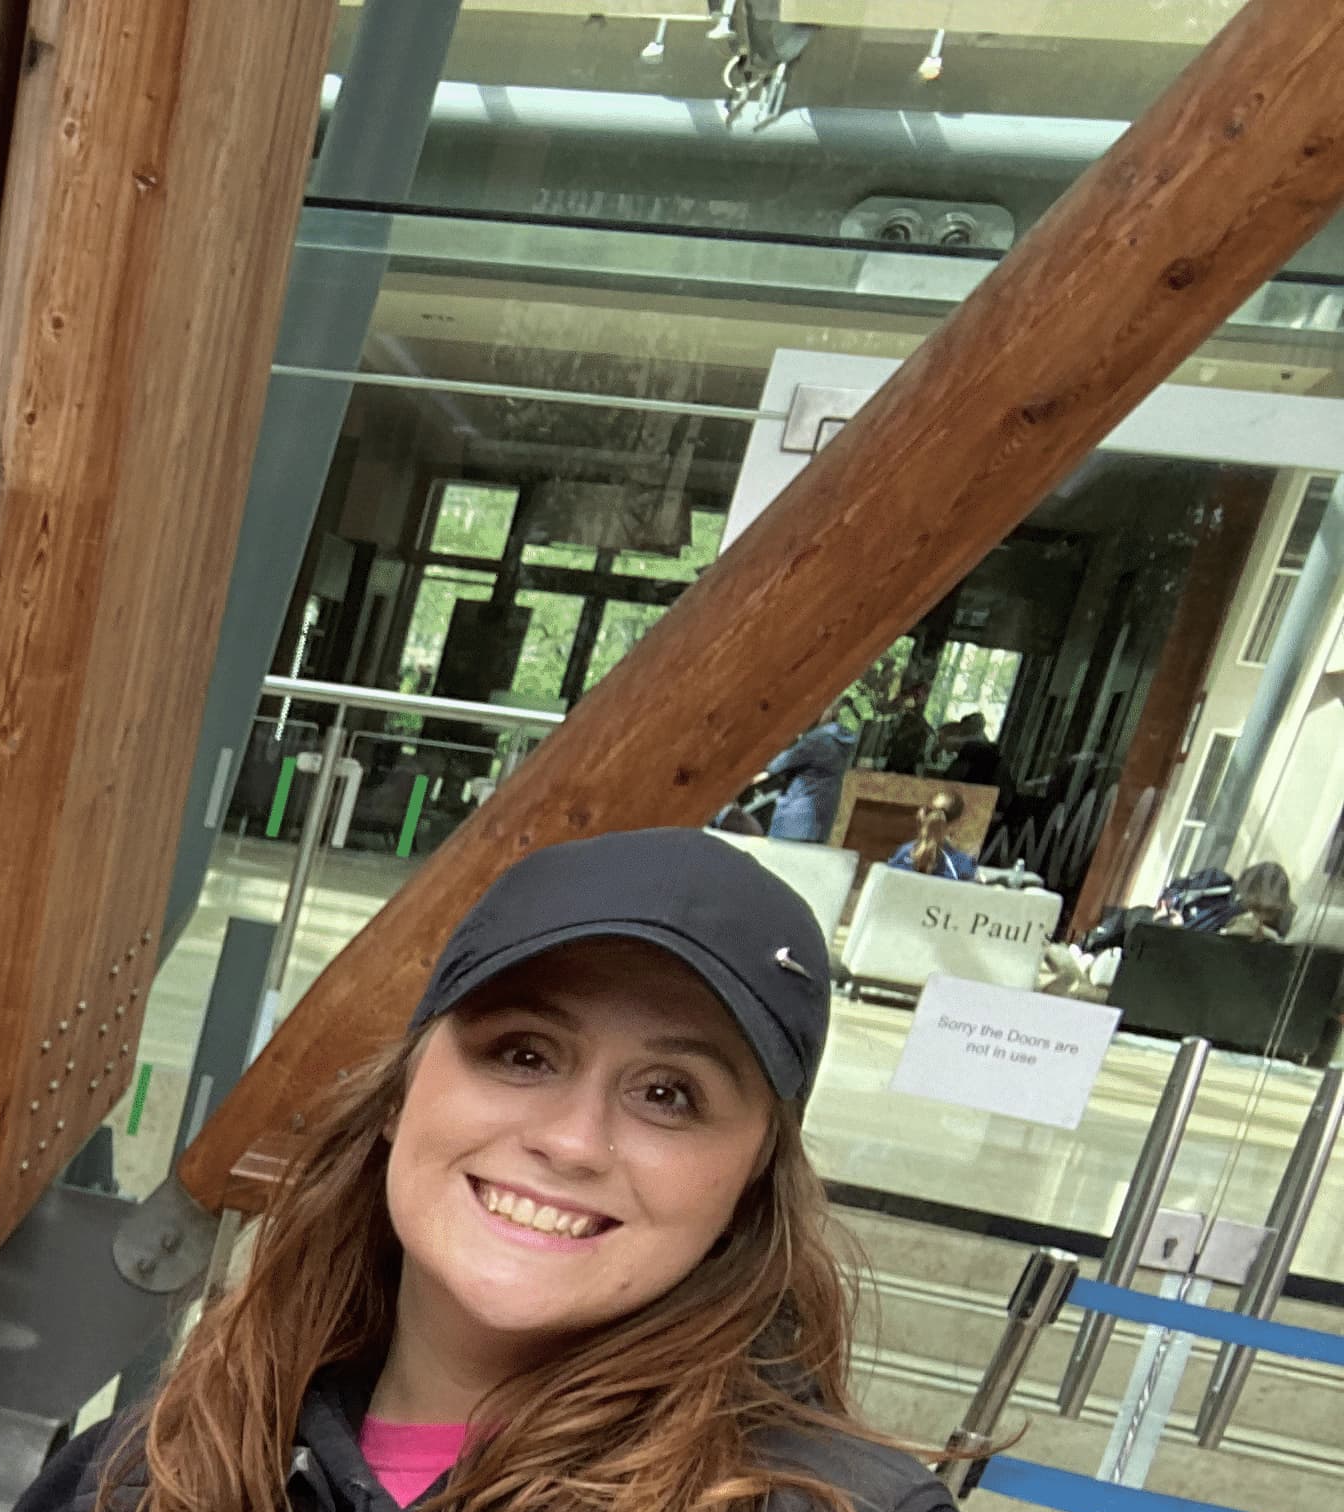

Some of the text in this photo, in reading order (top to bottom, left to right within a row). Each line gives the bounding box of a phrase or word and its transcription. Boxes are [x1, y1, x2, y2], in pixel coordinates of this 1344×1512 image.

[921, 905, 959, 931] St.
[937, 1014, 1080, 1055] Sorry the Doors are
[965, 1041, 1038, 1066] not in use
